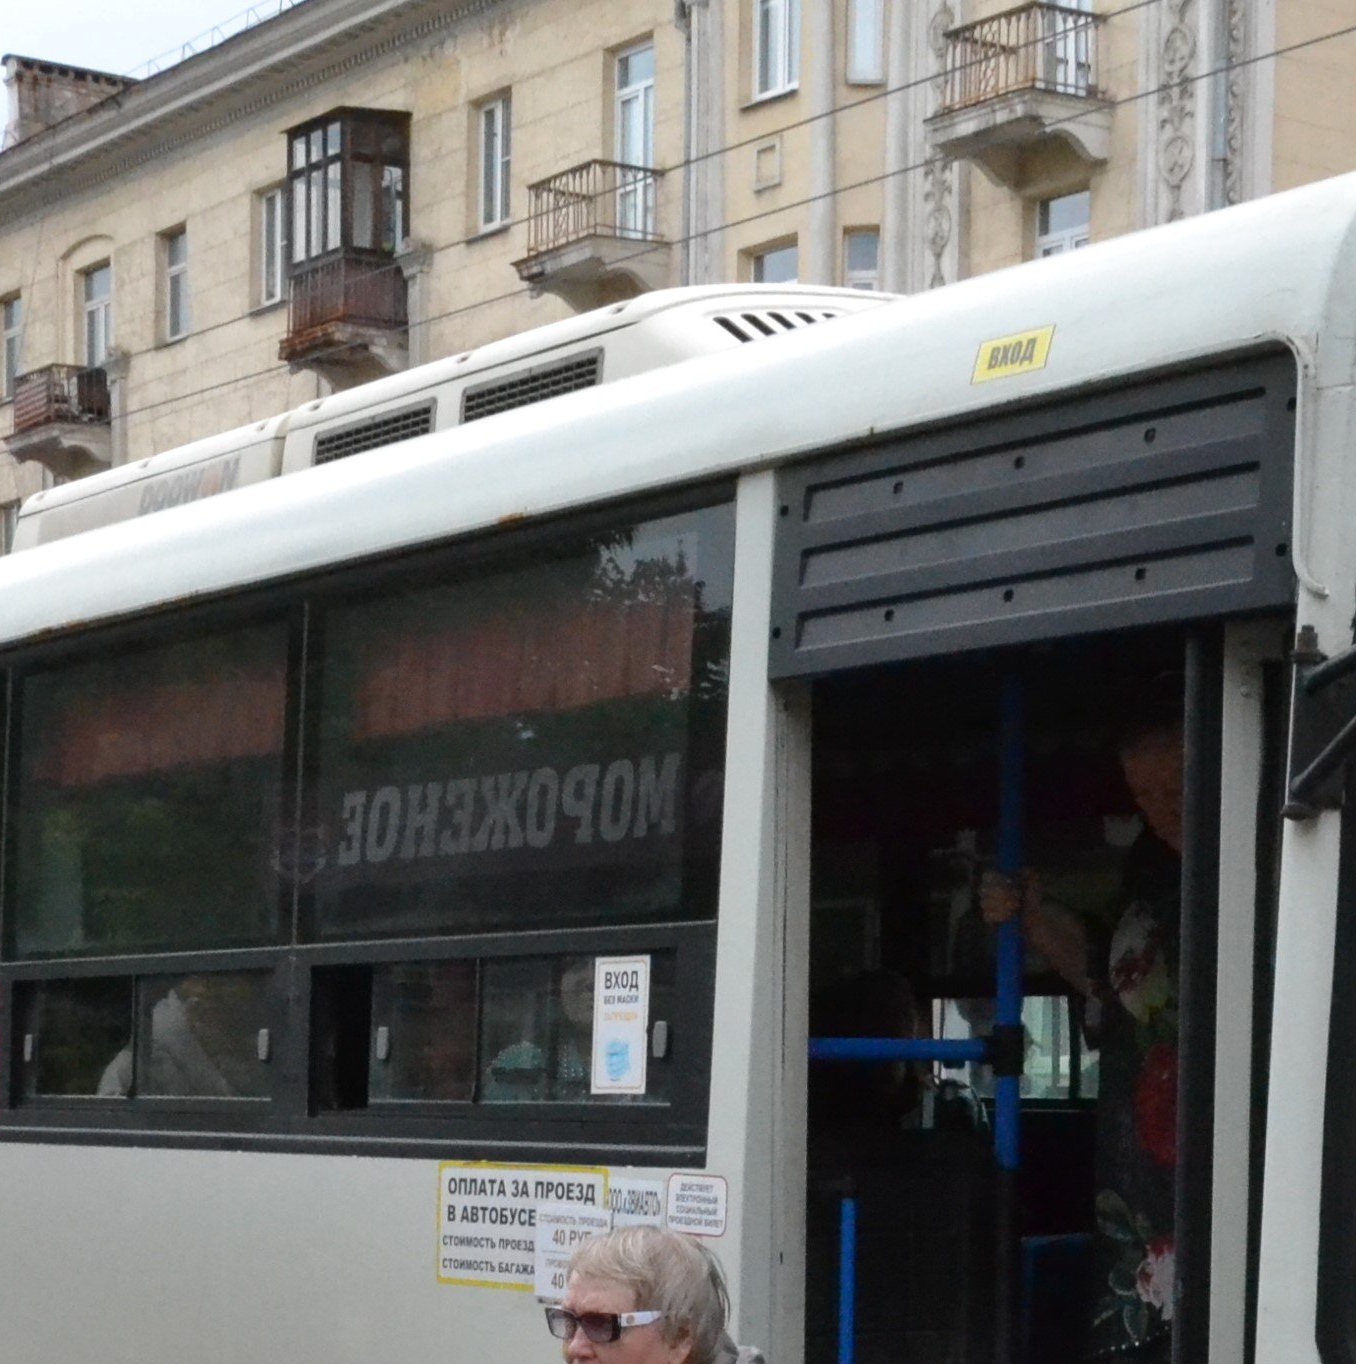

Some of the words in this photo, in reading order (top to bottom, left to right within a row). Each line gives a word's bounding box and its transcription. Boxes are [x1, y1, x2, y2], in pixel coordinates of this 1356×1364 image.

[987, 337, 1037, 370] ВХОД
[604, 971, 639, 992] ВХОД
[448, 1177, 507, 1197] ОПЛАТА
[511, 1180, 530, 1198] ЗА
[535, 1181, 596, 1206] ПРОЕЗД
[447, 1204, 456, 1222] В
[460, 1205, 536, 1227] АВТОБУСЕ
[442, 1234, 496, 1249] СТОИМОСТЬ
[552, 1229, 566, 1246] 40
[442, 1258, 496, 1273] СТОИМОСТЬ
[498, 1263, 535, 1276] БАГАЖА
[551, 1272, 564, 1289] 40
